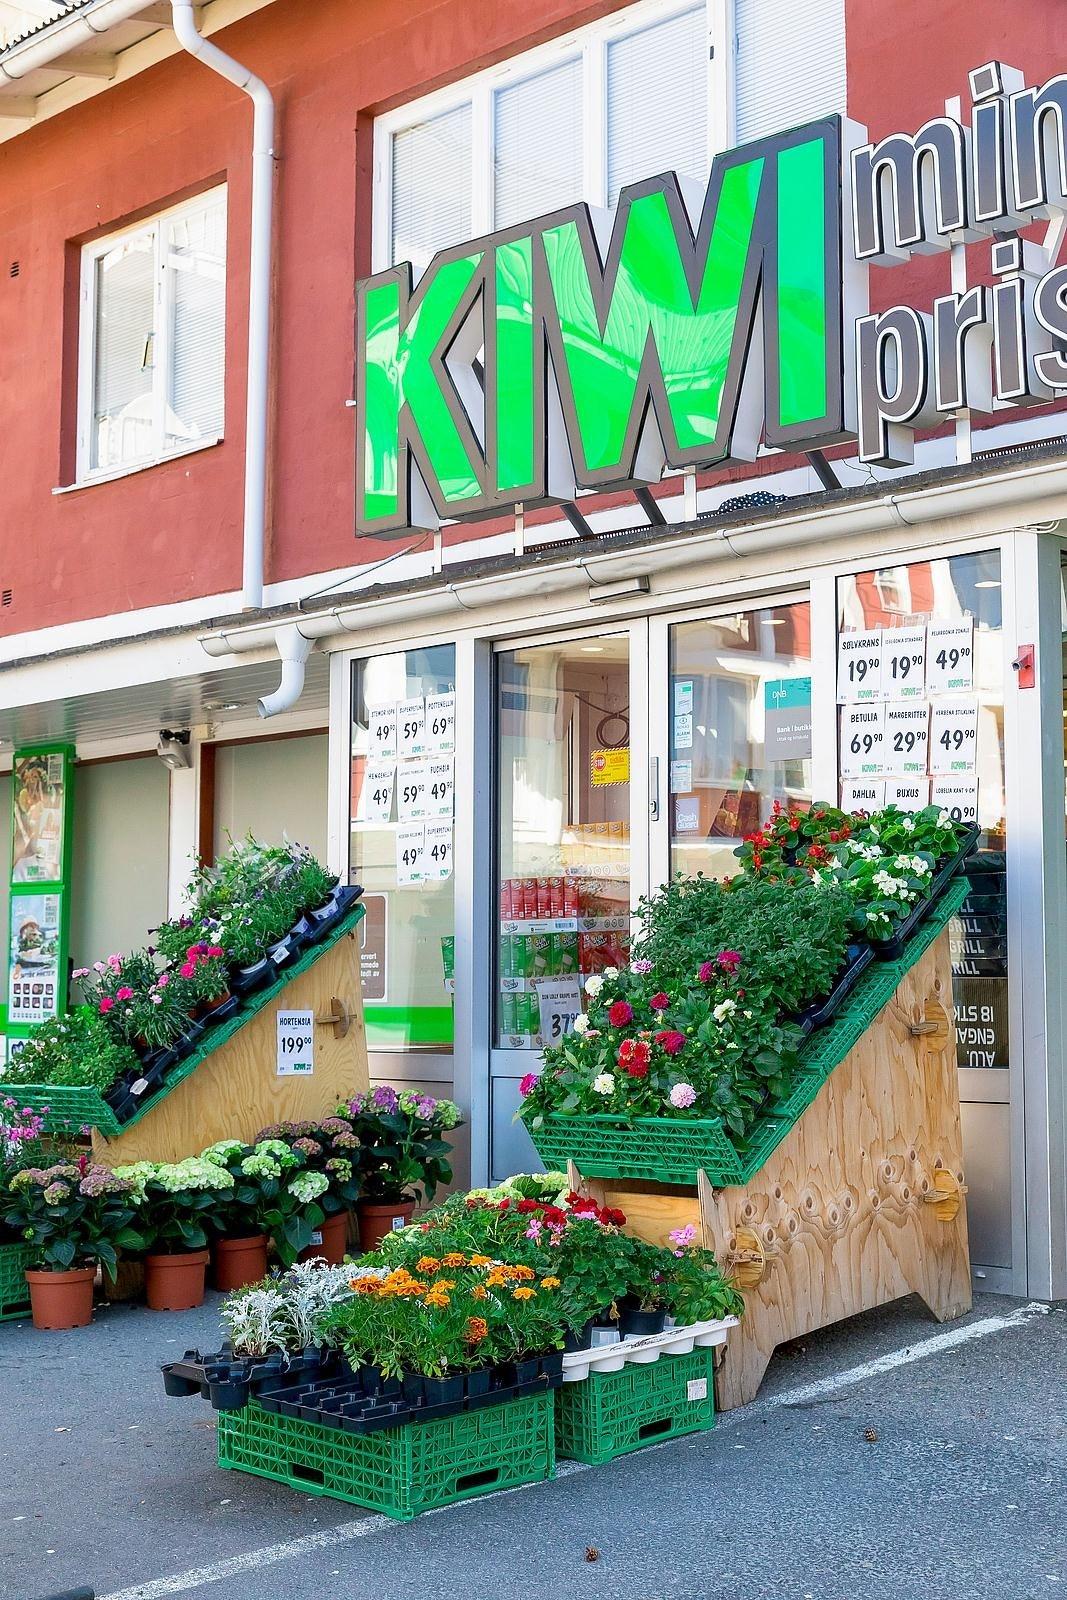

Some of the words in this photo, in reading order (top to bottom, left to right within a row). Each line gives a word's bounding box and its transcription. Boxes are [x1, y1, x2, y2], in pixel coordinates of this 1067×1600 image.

[356, 113, 843, 536] KIWI
[855, 238, 1067, 464] pris
[842, 638, 880, 650] SØLVKRANS
[851, 712, 878, 723] BETULIA
[889, 710, 927, 719] MARGERITTER
[852, 789, 876, 799] DAHLIA
[896, 788, 919, 798] BUXUS
[950, 939, 985, 954] GRILL
[951, 961, 980, 975] RILL
[279, 1017, 311, 1026] HORTENSIA
[966, 1050, 996, 1067] ALU.
